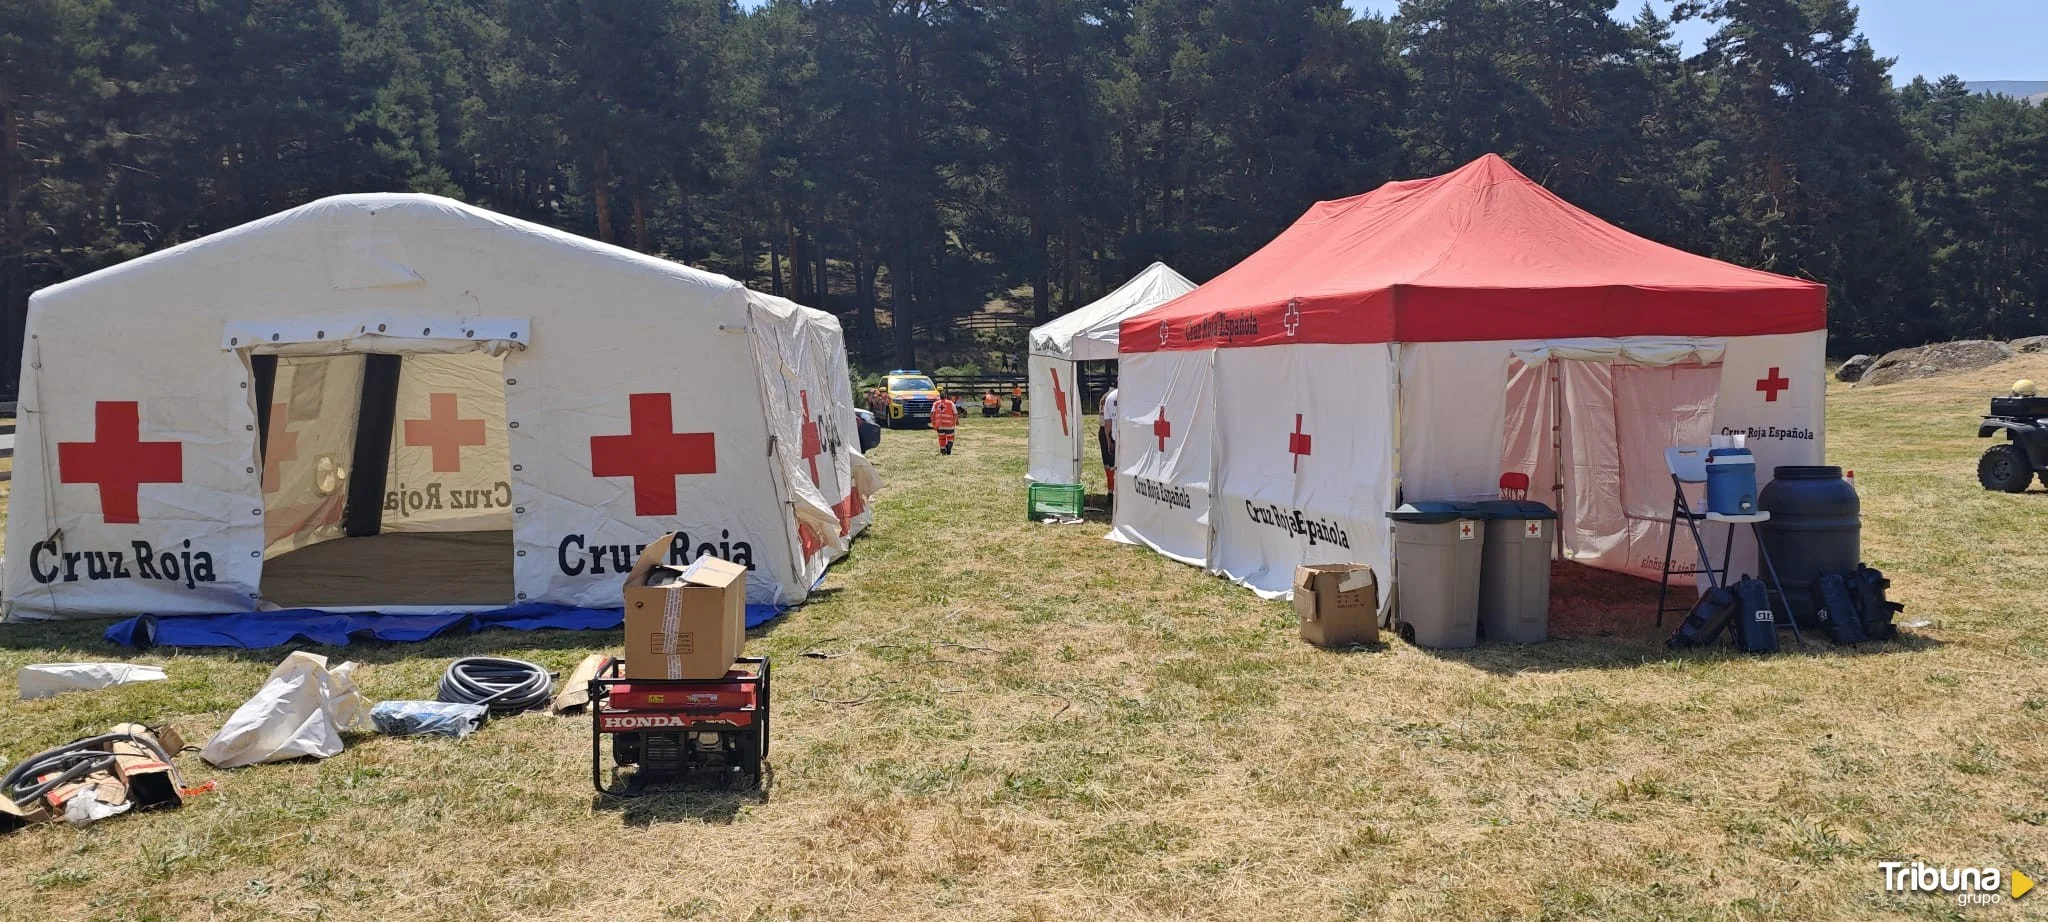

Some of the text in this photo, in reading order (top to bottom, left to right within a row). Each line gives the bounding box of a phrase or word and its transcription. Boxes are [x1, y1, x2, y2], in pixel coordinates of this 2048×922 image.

[1217, 310, 1258, 342] Española
[1748, 427, 1767, 440] Roja
[1769, 427, 1814, 440] Española
[1159, 482, 1191, 510] Española
[1246, 500, 1350, 550] Cruz Roja Epañola
[29, 539, 216, 589] Cruz Roja
[558, 534, 648, 576] Cru
[605, 716, 685, 728] HONDA
